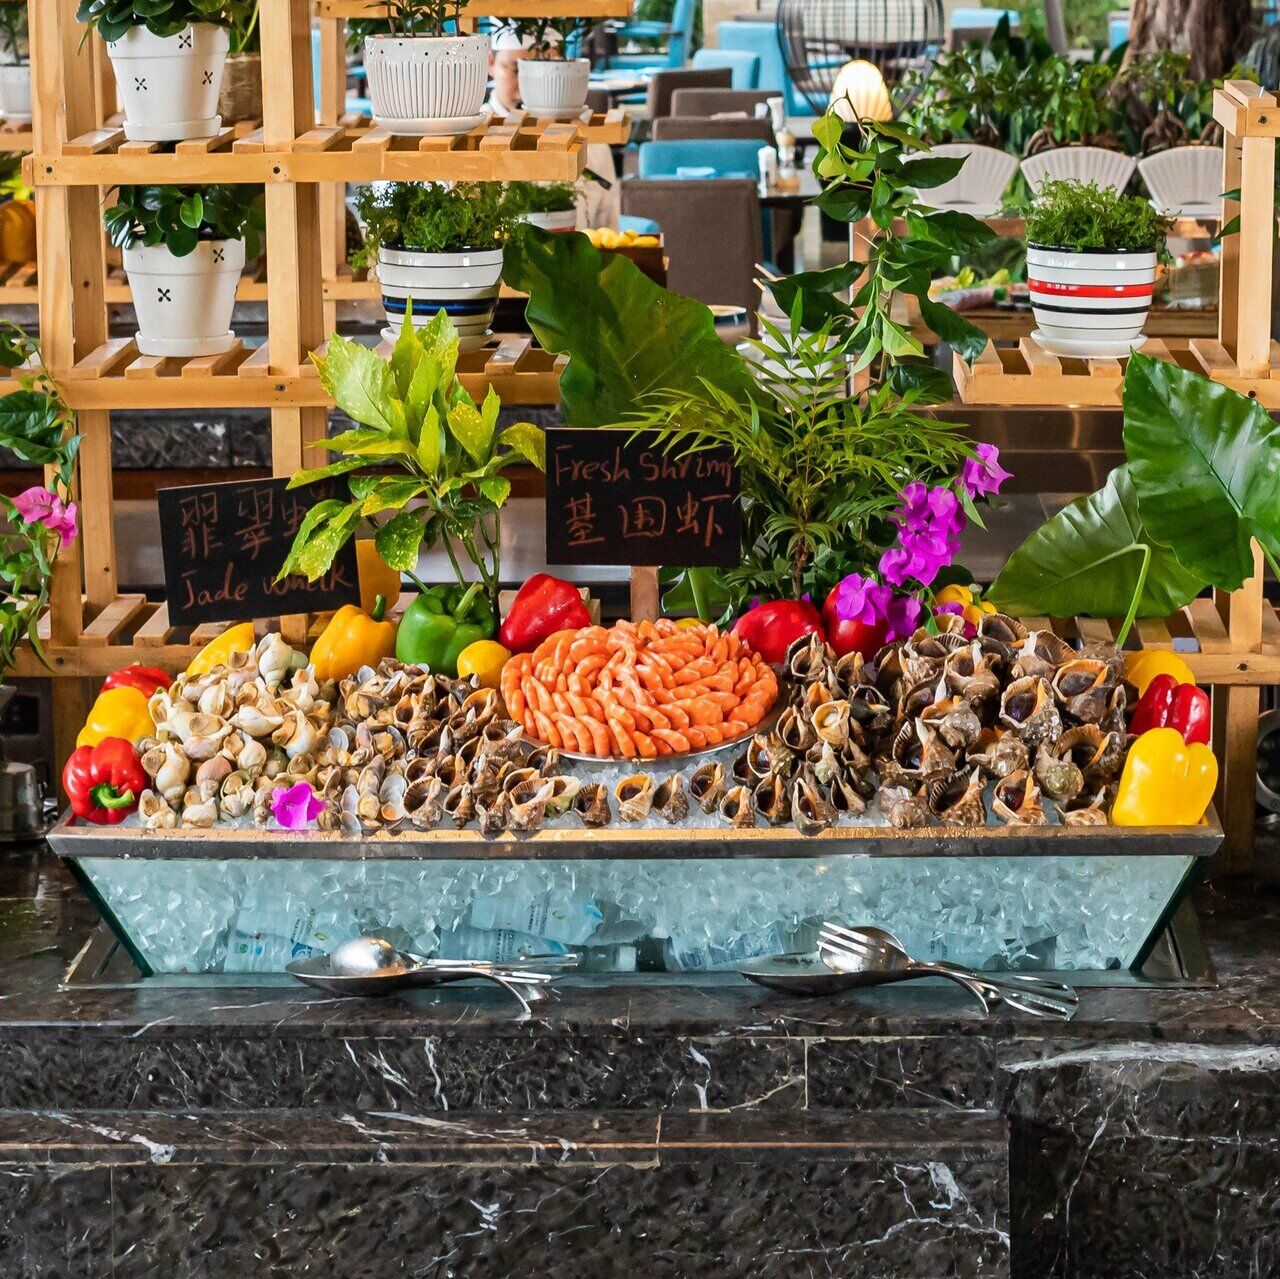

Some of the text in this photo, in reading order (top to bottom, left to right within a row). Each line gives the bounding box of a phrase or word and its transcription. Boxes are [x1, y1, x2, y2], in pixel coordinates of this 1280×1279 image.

[554, 445, 631, 486] Fresh
[565, 491, 732, 547] 基围虾
[180, 561, 250, 610] Jade
